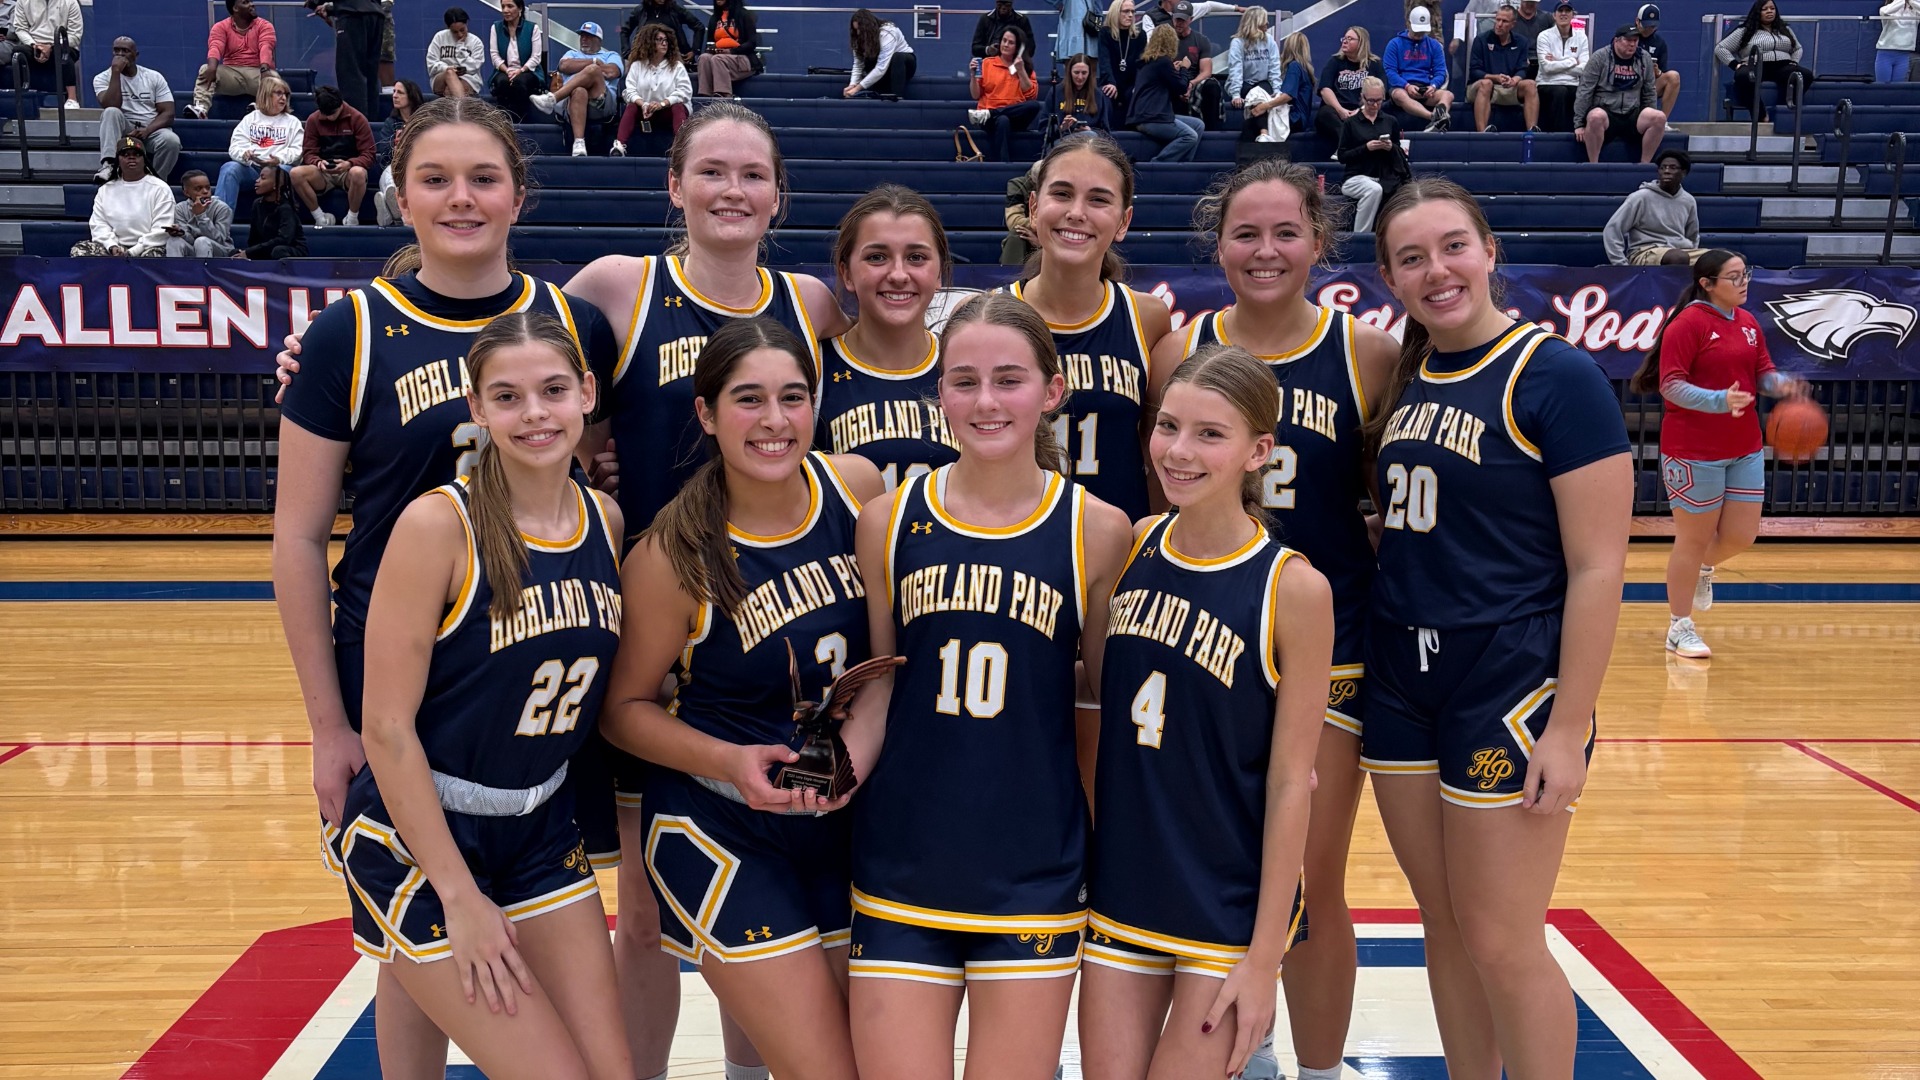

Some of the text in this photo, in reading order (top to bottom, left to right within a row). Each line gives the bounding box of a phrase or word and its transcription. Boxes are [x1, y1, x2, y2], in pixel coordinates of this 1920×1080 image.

[1, 284, 268, 349] ALLEN
[1552, 283, 1676, 352] Soa
[394, 356, 474, 427] HIGHLA
[658, 335, 708, 388] HIGH
[1099, 354, 1141, 406] PARK
[829, 399, 922, 455] HIGHLAND
[1291, 387, 1338, 443] PARK
[1434, 405, 1486, 466] PARK
[1384, 463, 1438, 533] 20
[731, 560, 837, 655] HIGHLAND
[900, 563, 1064, 641] HIGHLAND PARK
[935, 638, 1009, 719] 10
[1184, 608, 1246, 690] PARK
[514, 656, 600, 737] 22
[1131, 670, 1167, 750] 4
[1466, 746, 1515, 791] HP
